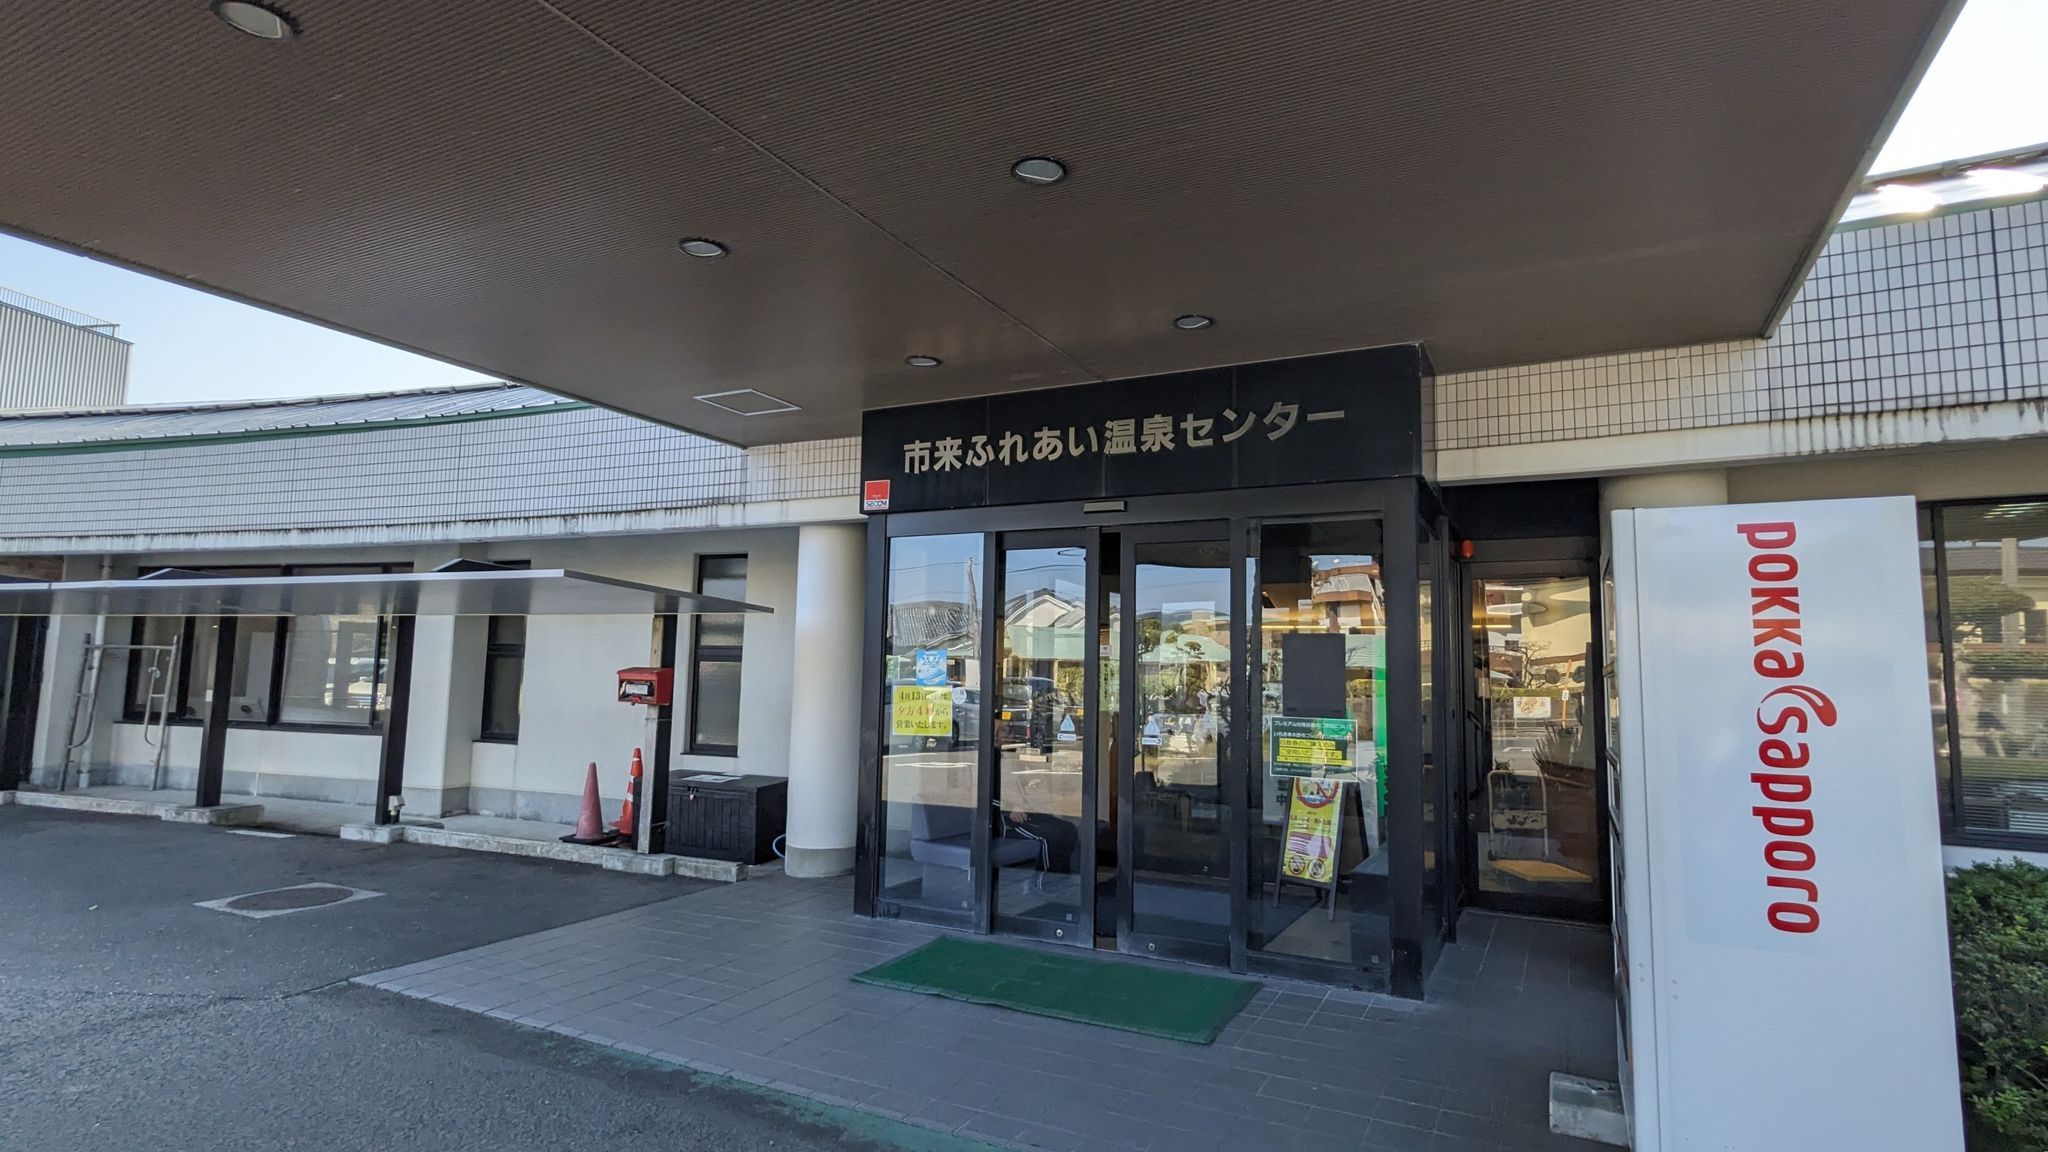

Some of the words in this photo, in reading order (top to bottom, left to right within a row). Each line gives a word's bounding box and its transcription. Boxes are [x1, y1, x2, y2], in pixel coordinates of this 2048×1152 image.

[903, 401, 1345, 474] 市来ふれあい温泉センター
